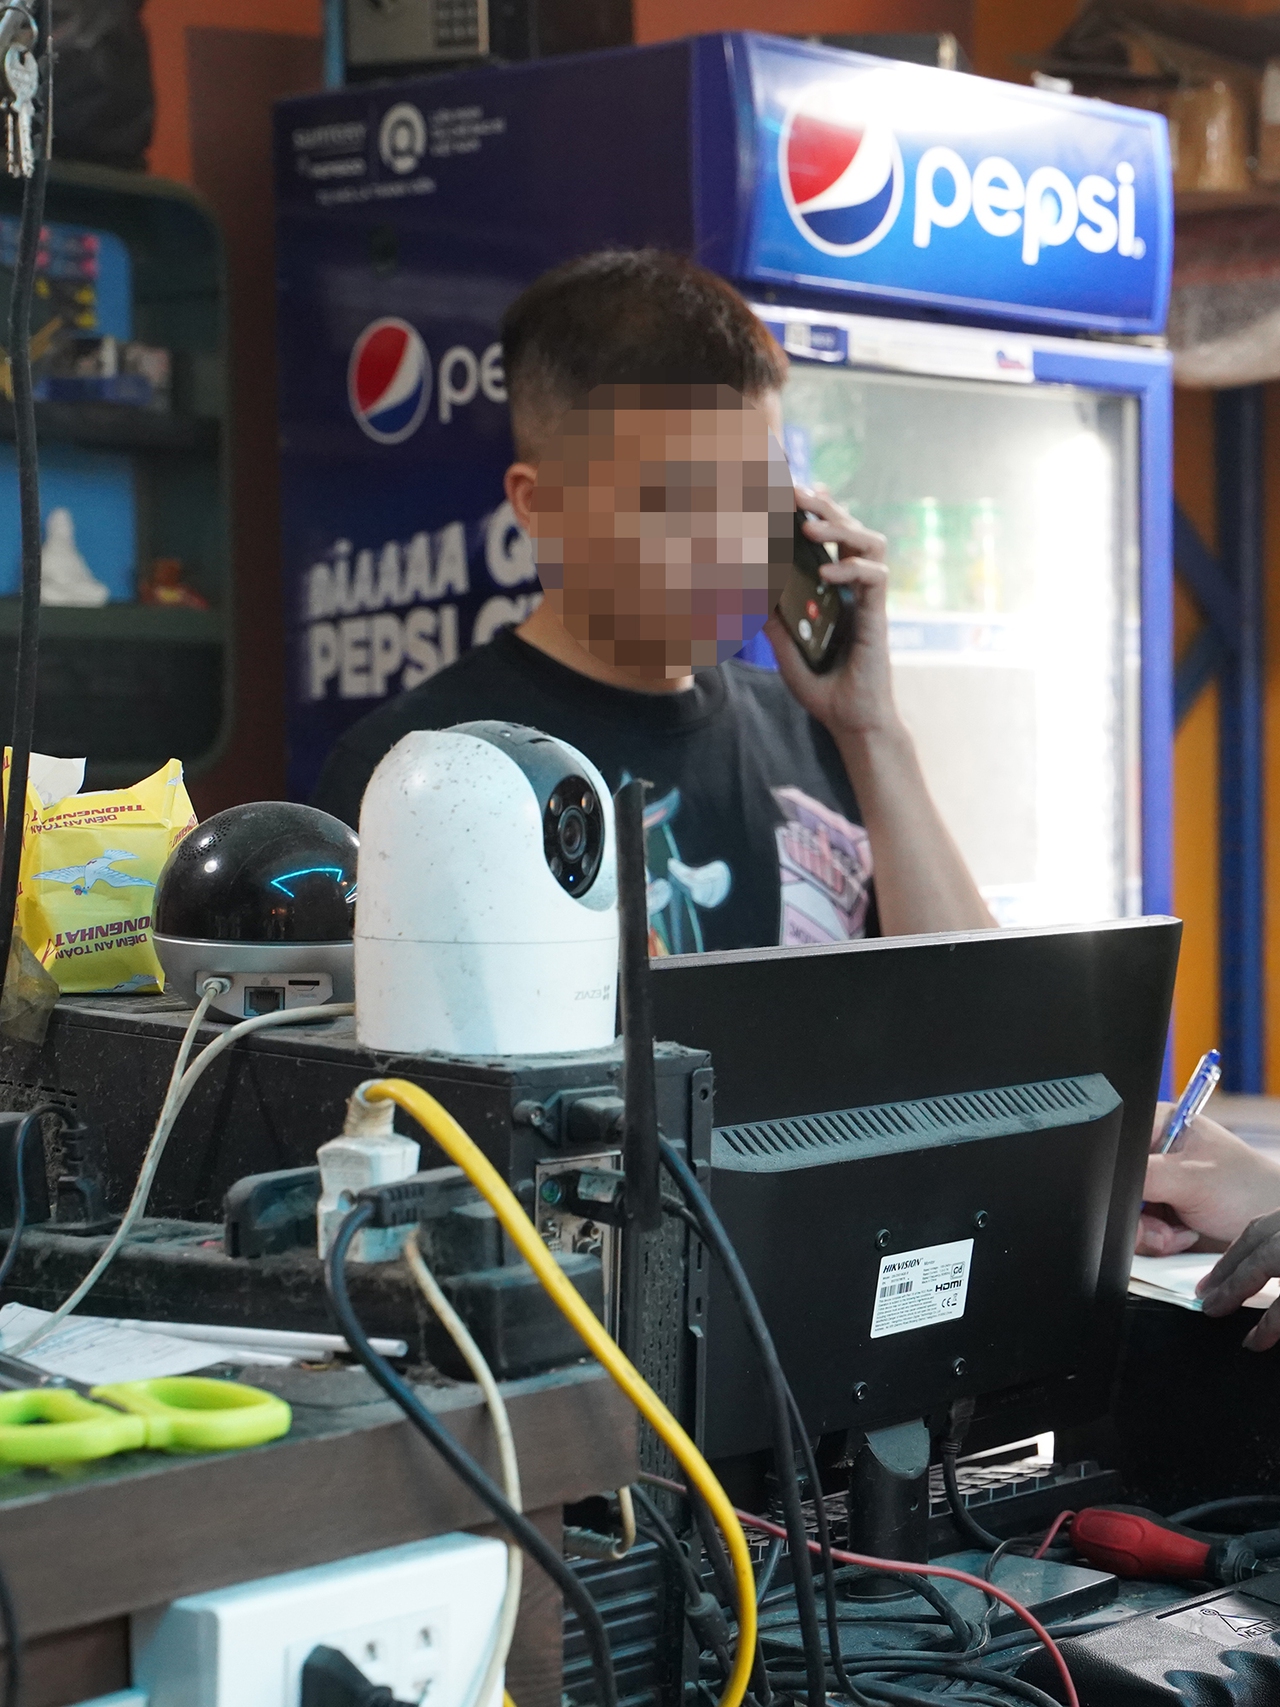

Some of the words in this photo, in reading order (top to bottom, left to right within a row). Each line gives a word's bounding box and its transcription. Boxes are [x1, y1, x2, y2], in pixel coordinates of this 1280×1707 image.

[913, 146, 1136, 265] pepsi
[308, 603, 460, 698] PEPSI
[63, 818, 82, 827] AN
[85, 814, 118, 825] DIÊM
[54, 916, 152, 948] ONGNHAT
[115, 932, 148, 948] DIÊM
[54, 944, 93, 960] TOÀN
[93, 939, 114, 952] AN
[574, 989, 602, 1001] EZVIZ
[883, 1258, 921, 1274] HIKVISION
